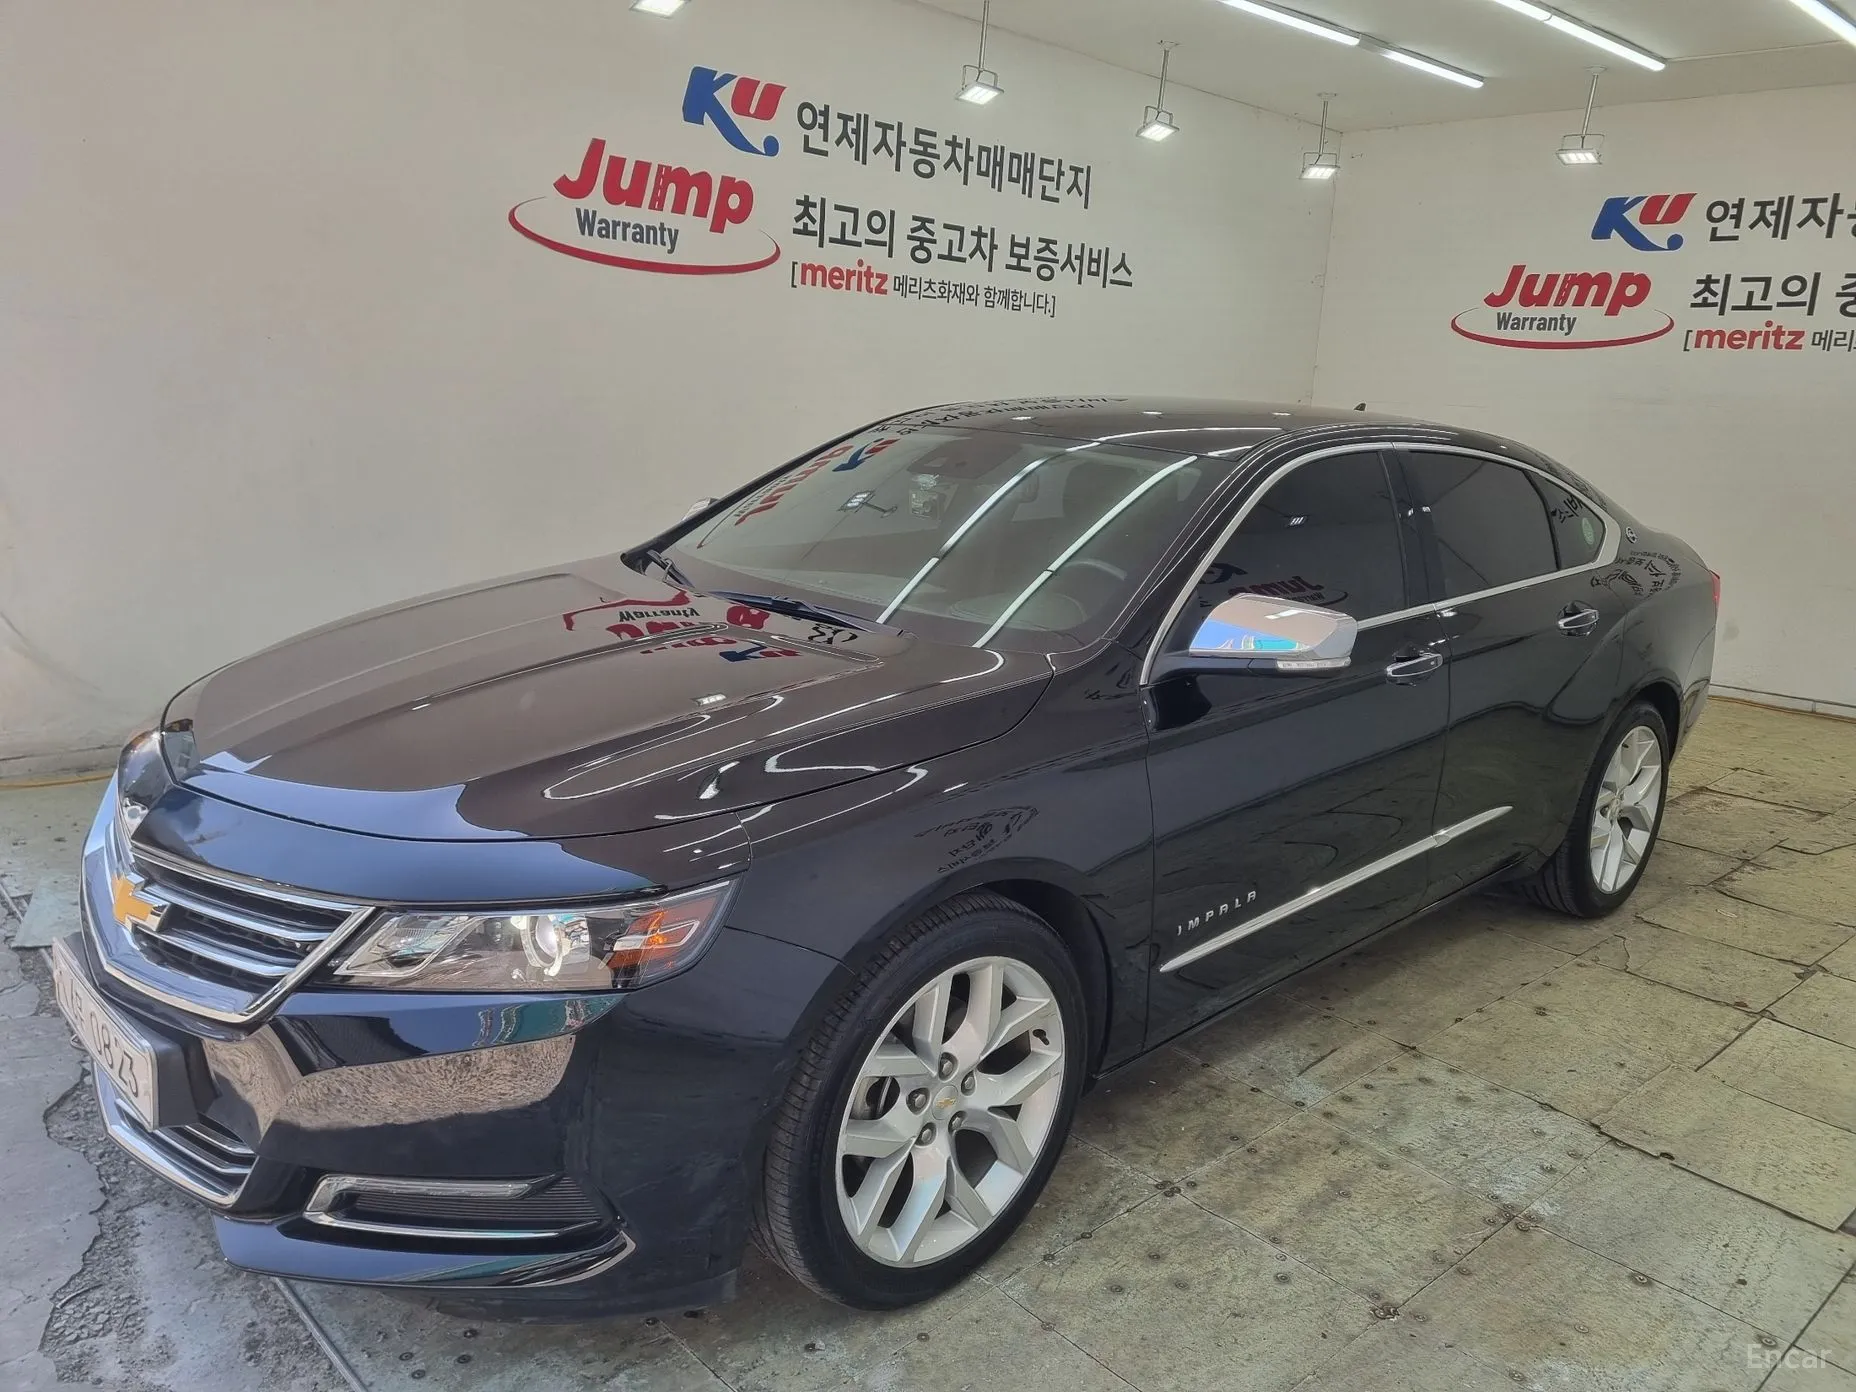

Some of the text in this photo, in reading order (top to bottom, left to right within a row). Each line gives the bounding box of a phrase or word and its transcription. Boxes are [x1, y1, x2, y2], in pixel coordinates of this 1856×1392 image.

[797, 101, 1091, 210] 연제자동차매매단지
[553, 137, 754, 234] Jump
[575, 207, 679, 254] Warranty
[1706, 193, 1856, 242] 연제자
[792, 194, 1133, 289] 최고의 중고차 보증서비스
[893, 273, 980, 304] 메리츠화재와
[1483, 265, 1652, 317] Jump
[1690, 272, 1822, 317] 최고의
[1496, 311, 1577, 337] Warranty
[1811, 329, 1856, 352] 메리
[1177, 890, 1257, 936] IMPALA
